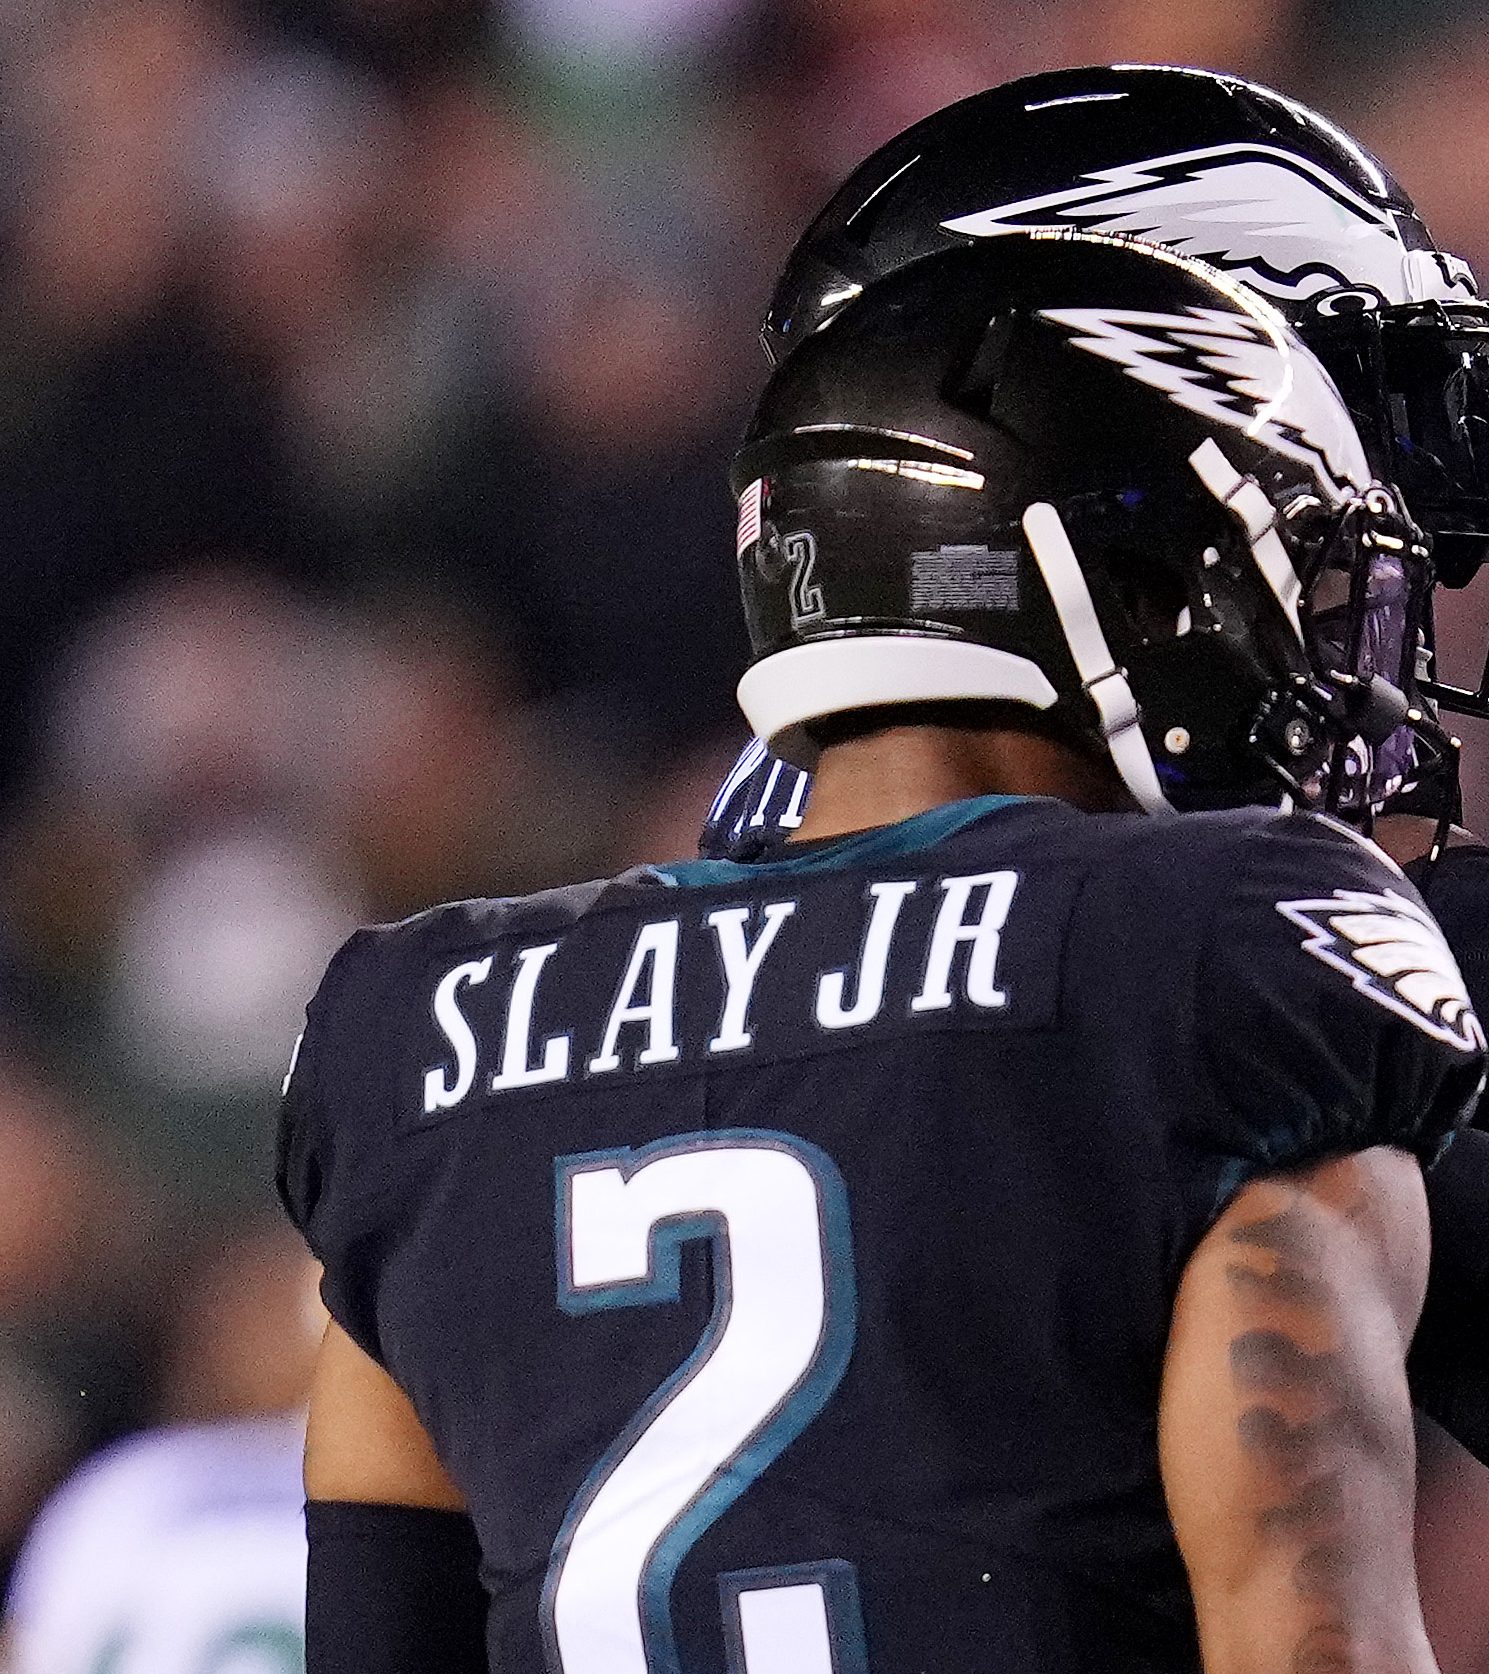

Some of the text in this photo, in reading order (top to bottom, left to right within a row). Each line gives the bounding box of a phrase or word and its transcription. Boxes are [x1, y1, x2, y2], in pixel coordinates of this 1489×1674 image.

[783, 531, 826, 630] 2
[423, 870, 1019, 1113] SLAY JR
